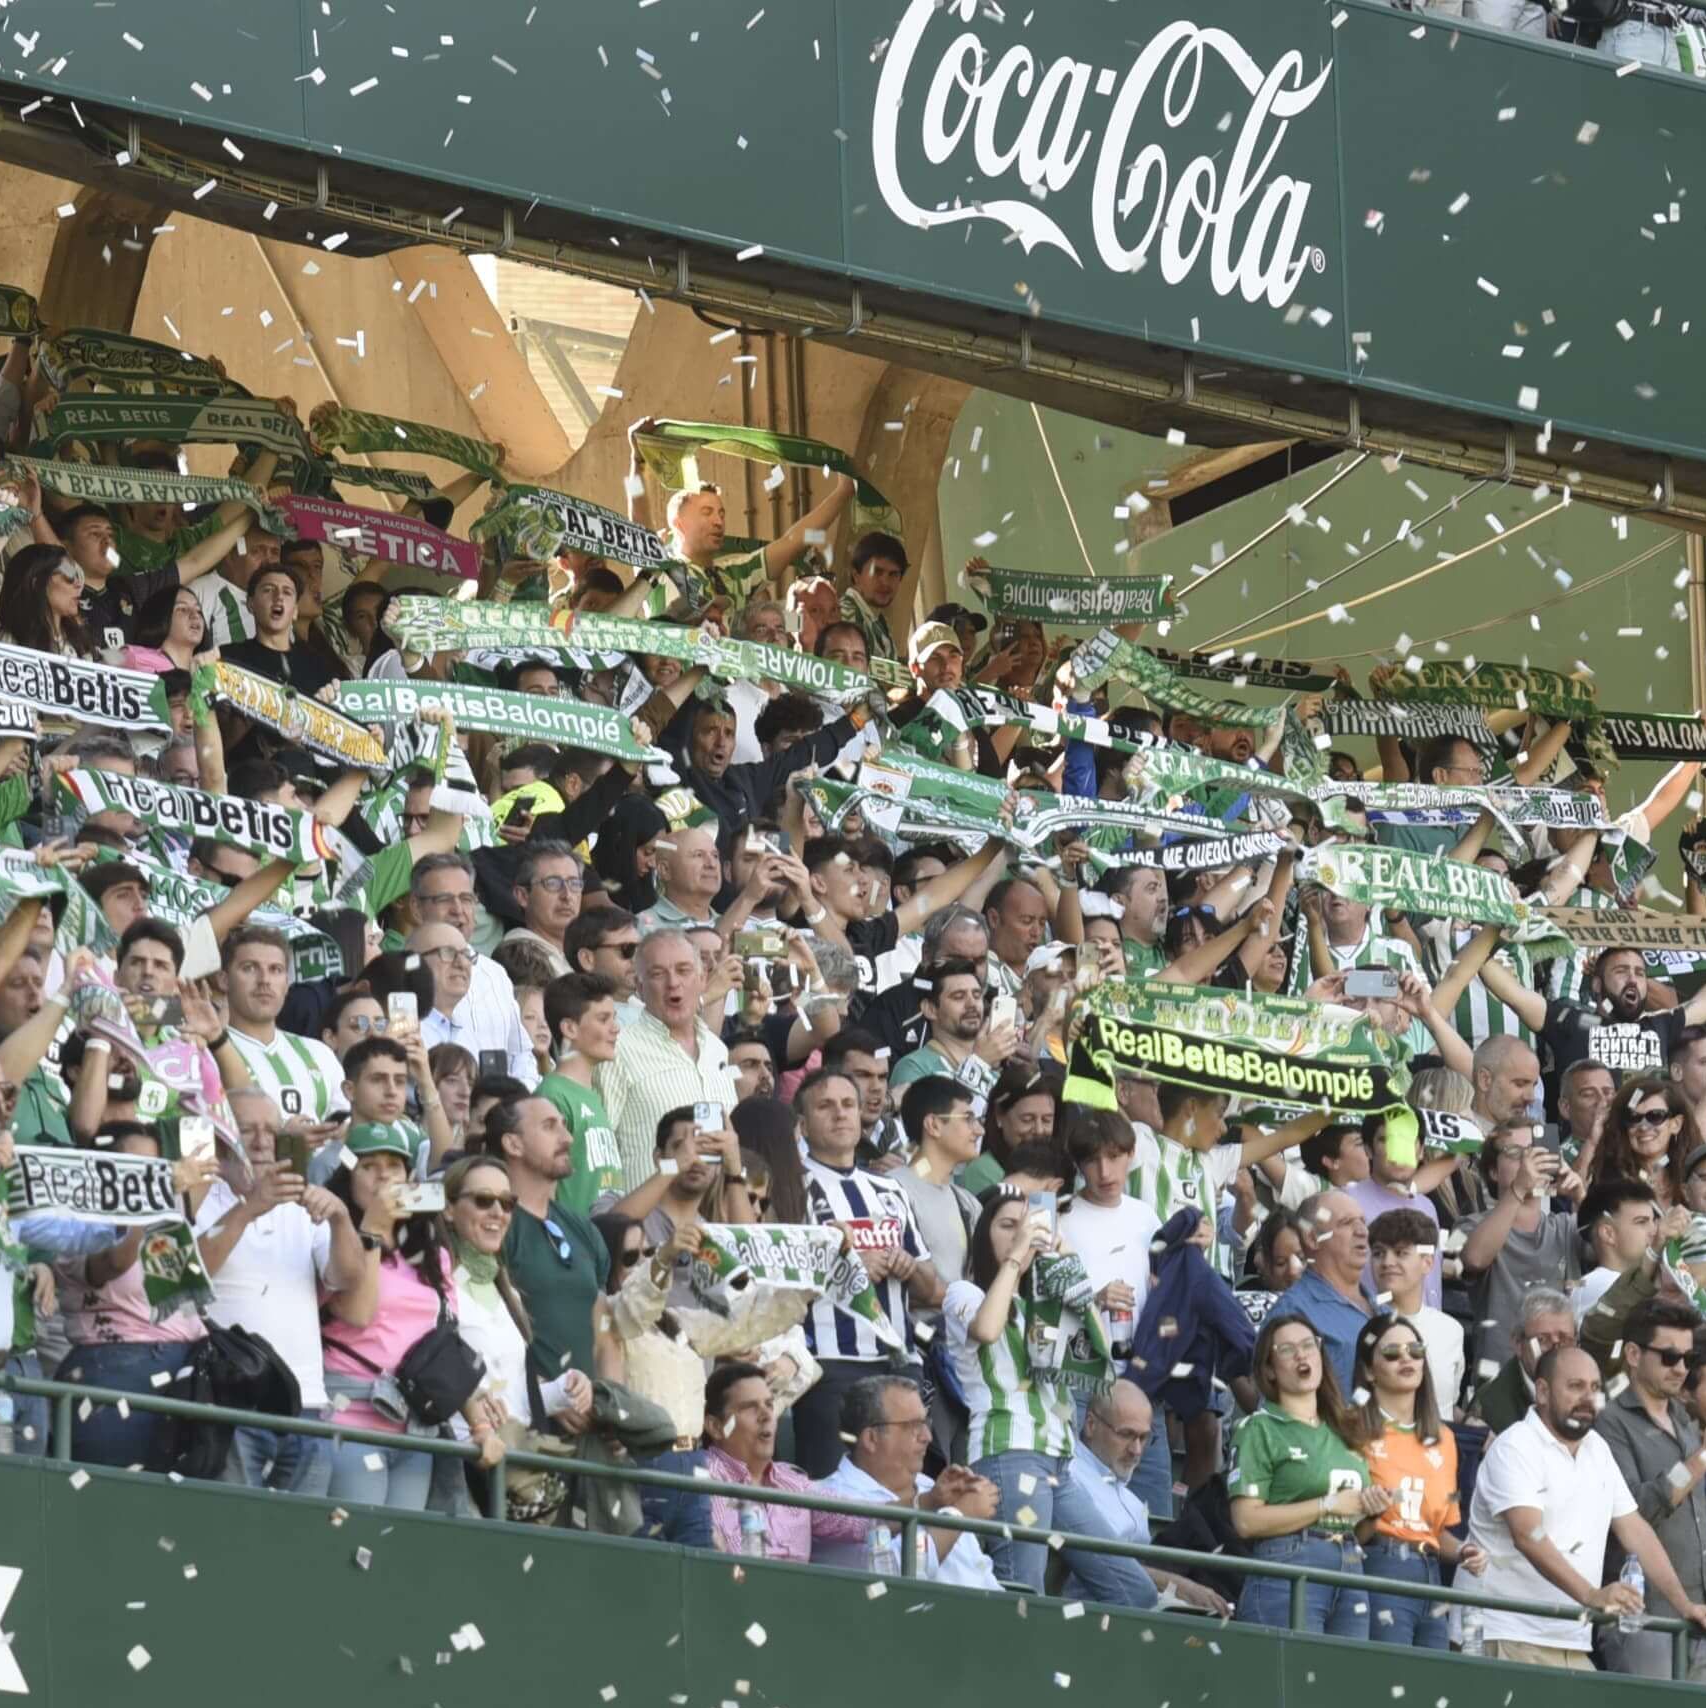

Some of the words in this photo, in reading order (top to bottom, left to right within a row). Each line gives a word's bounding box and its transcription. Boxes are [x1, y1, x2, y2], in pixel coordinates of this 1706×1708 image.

[873, 0, 1333, 308] Coca-Cola
[65, 407, 116, 426] REAL
[120, 409, 171, 426] BETIS
[323, 520, 462, 572] BÉTICA
[105, 769, 293, 850] RealBetis
[1186, 840, 1232, 868] QUEDO
[1336, 850, 1439, 897] REAL
[1099, 1017, 1375, 1101] RealBetisBalompié
